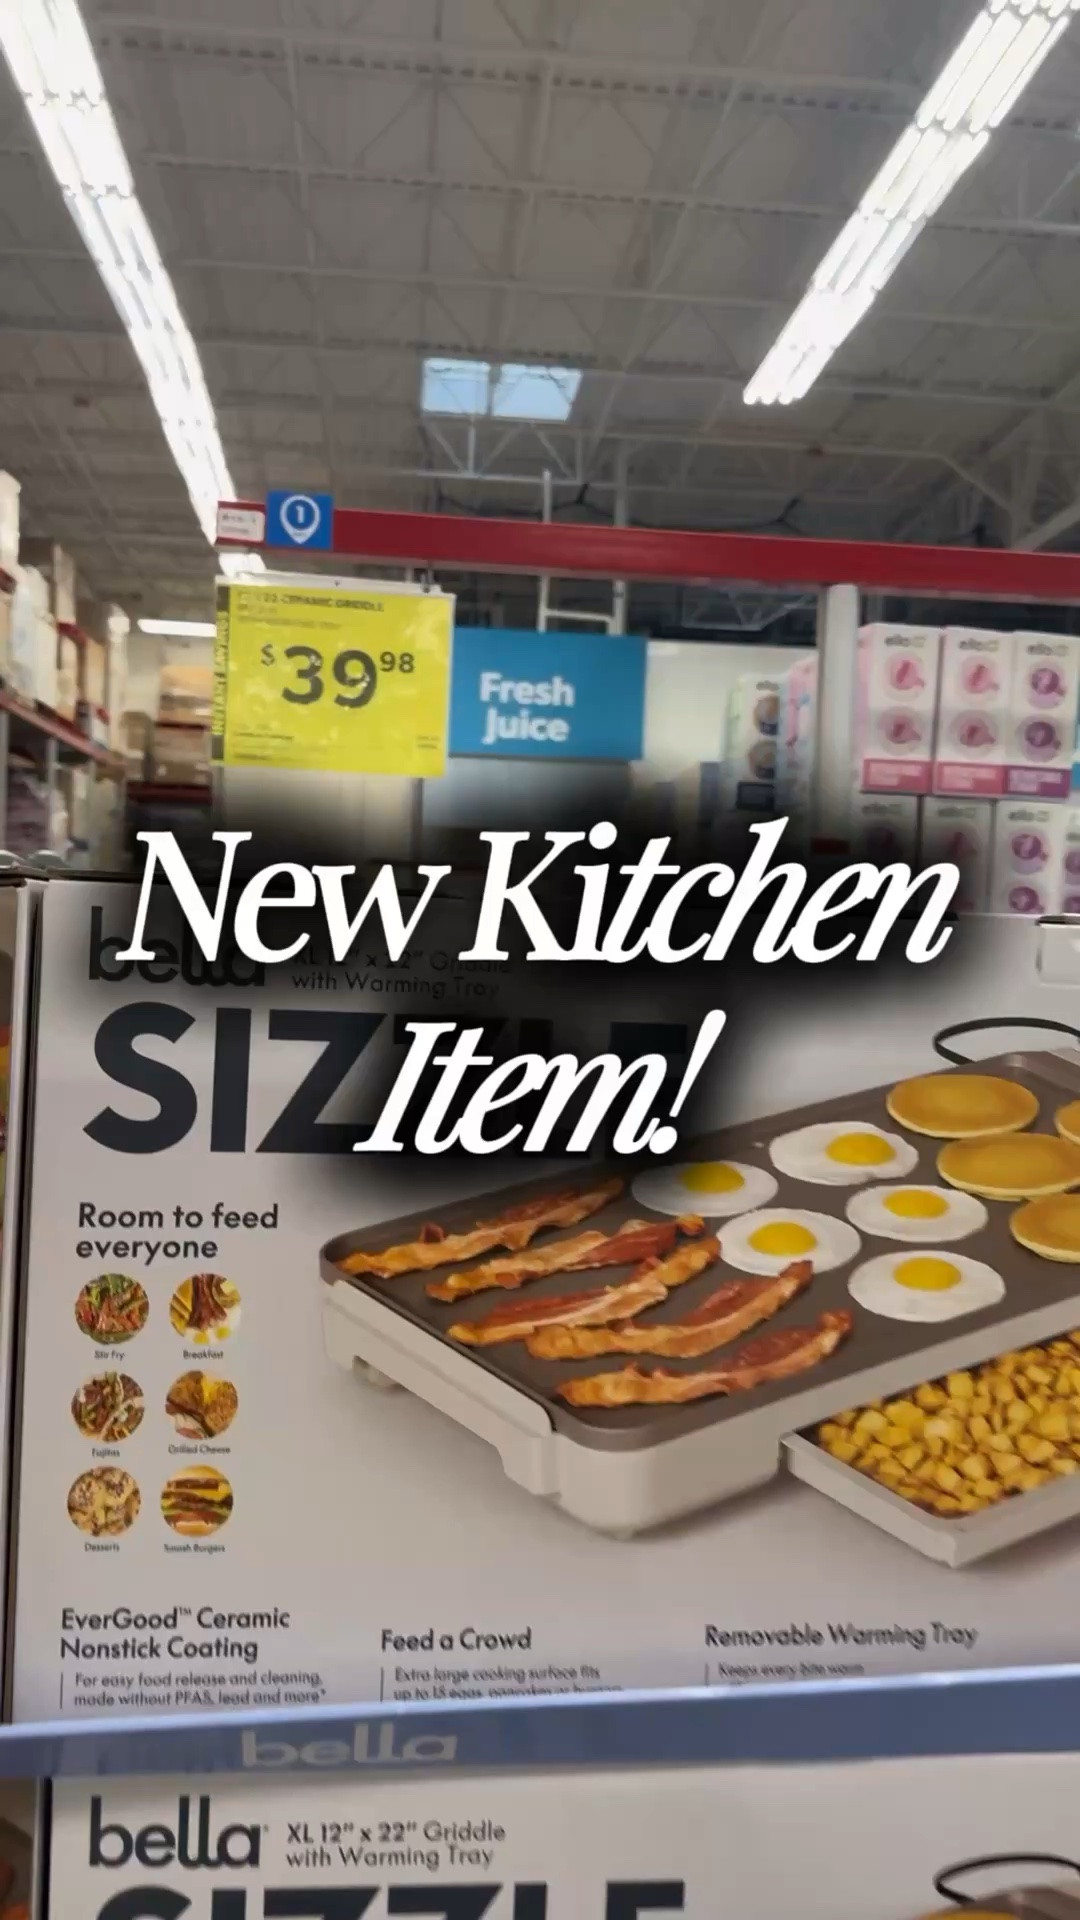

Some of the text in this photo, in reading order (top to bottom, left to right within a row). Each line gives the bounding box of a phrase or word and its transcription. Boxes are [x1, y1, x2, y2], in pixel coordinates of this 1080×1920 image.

[296, 505, 305, 523] 1
[480, 671, 574, 707] Fresh
[482, 706, 569, 745] Juice
[291, 971, 337, 991] with
[344, 972, 447, 1000] Warming
[78, 1202, 279, 1229] Room to feed
[75, 1240, 218, 1266] everyone
[182, 1350, 224, 1360] Breakfast
[197, 1607, 290, 1629] Ceramic
[381, 1626, 532, 1651] Feed a Crowd
[705, 1621, 979, 1651] Removable Warming Tray
[60, 1636, 258, 1663] Nonstick Coating
[75, 1672, 98, 1688] For
[101, 1675, 134, 1689] easy
[138, 1671, 172, 1687] food
[175, 1671, 226, 1686] release
[229, 1671, 257, 1685] and
[74, 1691, 115, 1706] made
[119, 1690, 171, 1706] without
[219, 1689, 250, 1704] lead
[252, 1688, 281, 1703] and
[89, 1794, 262, 1869] bella
[287, 1822, 314, 1844] XL
[360, 1827, 372, 1842] x
[423, 1819, 506, 1842] Griddle
[286, 1843, 494, 1872] with Warming Tray
